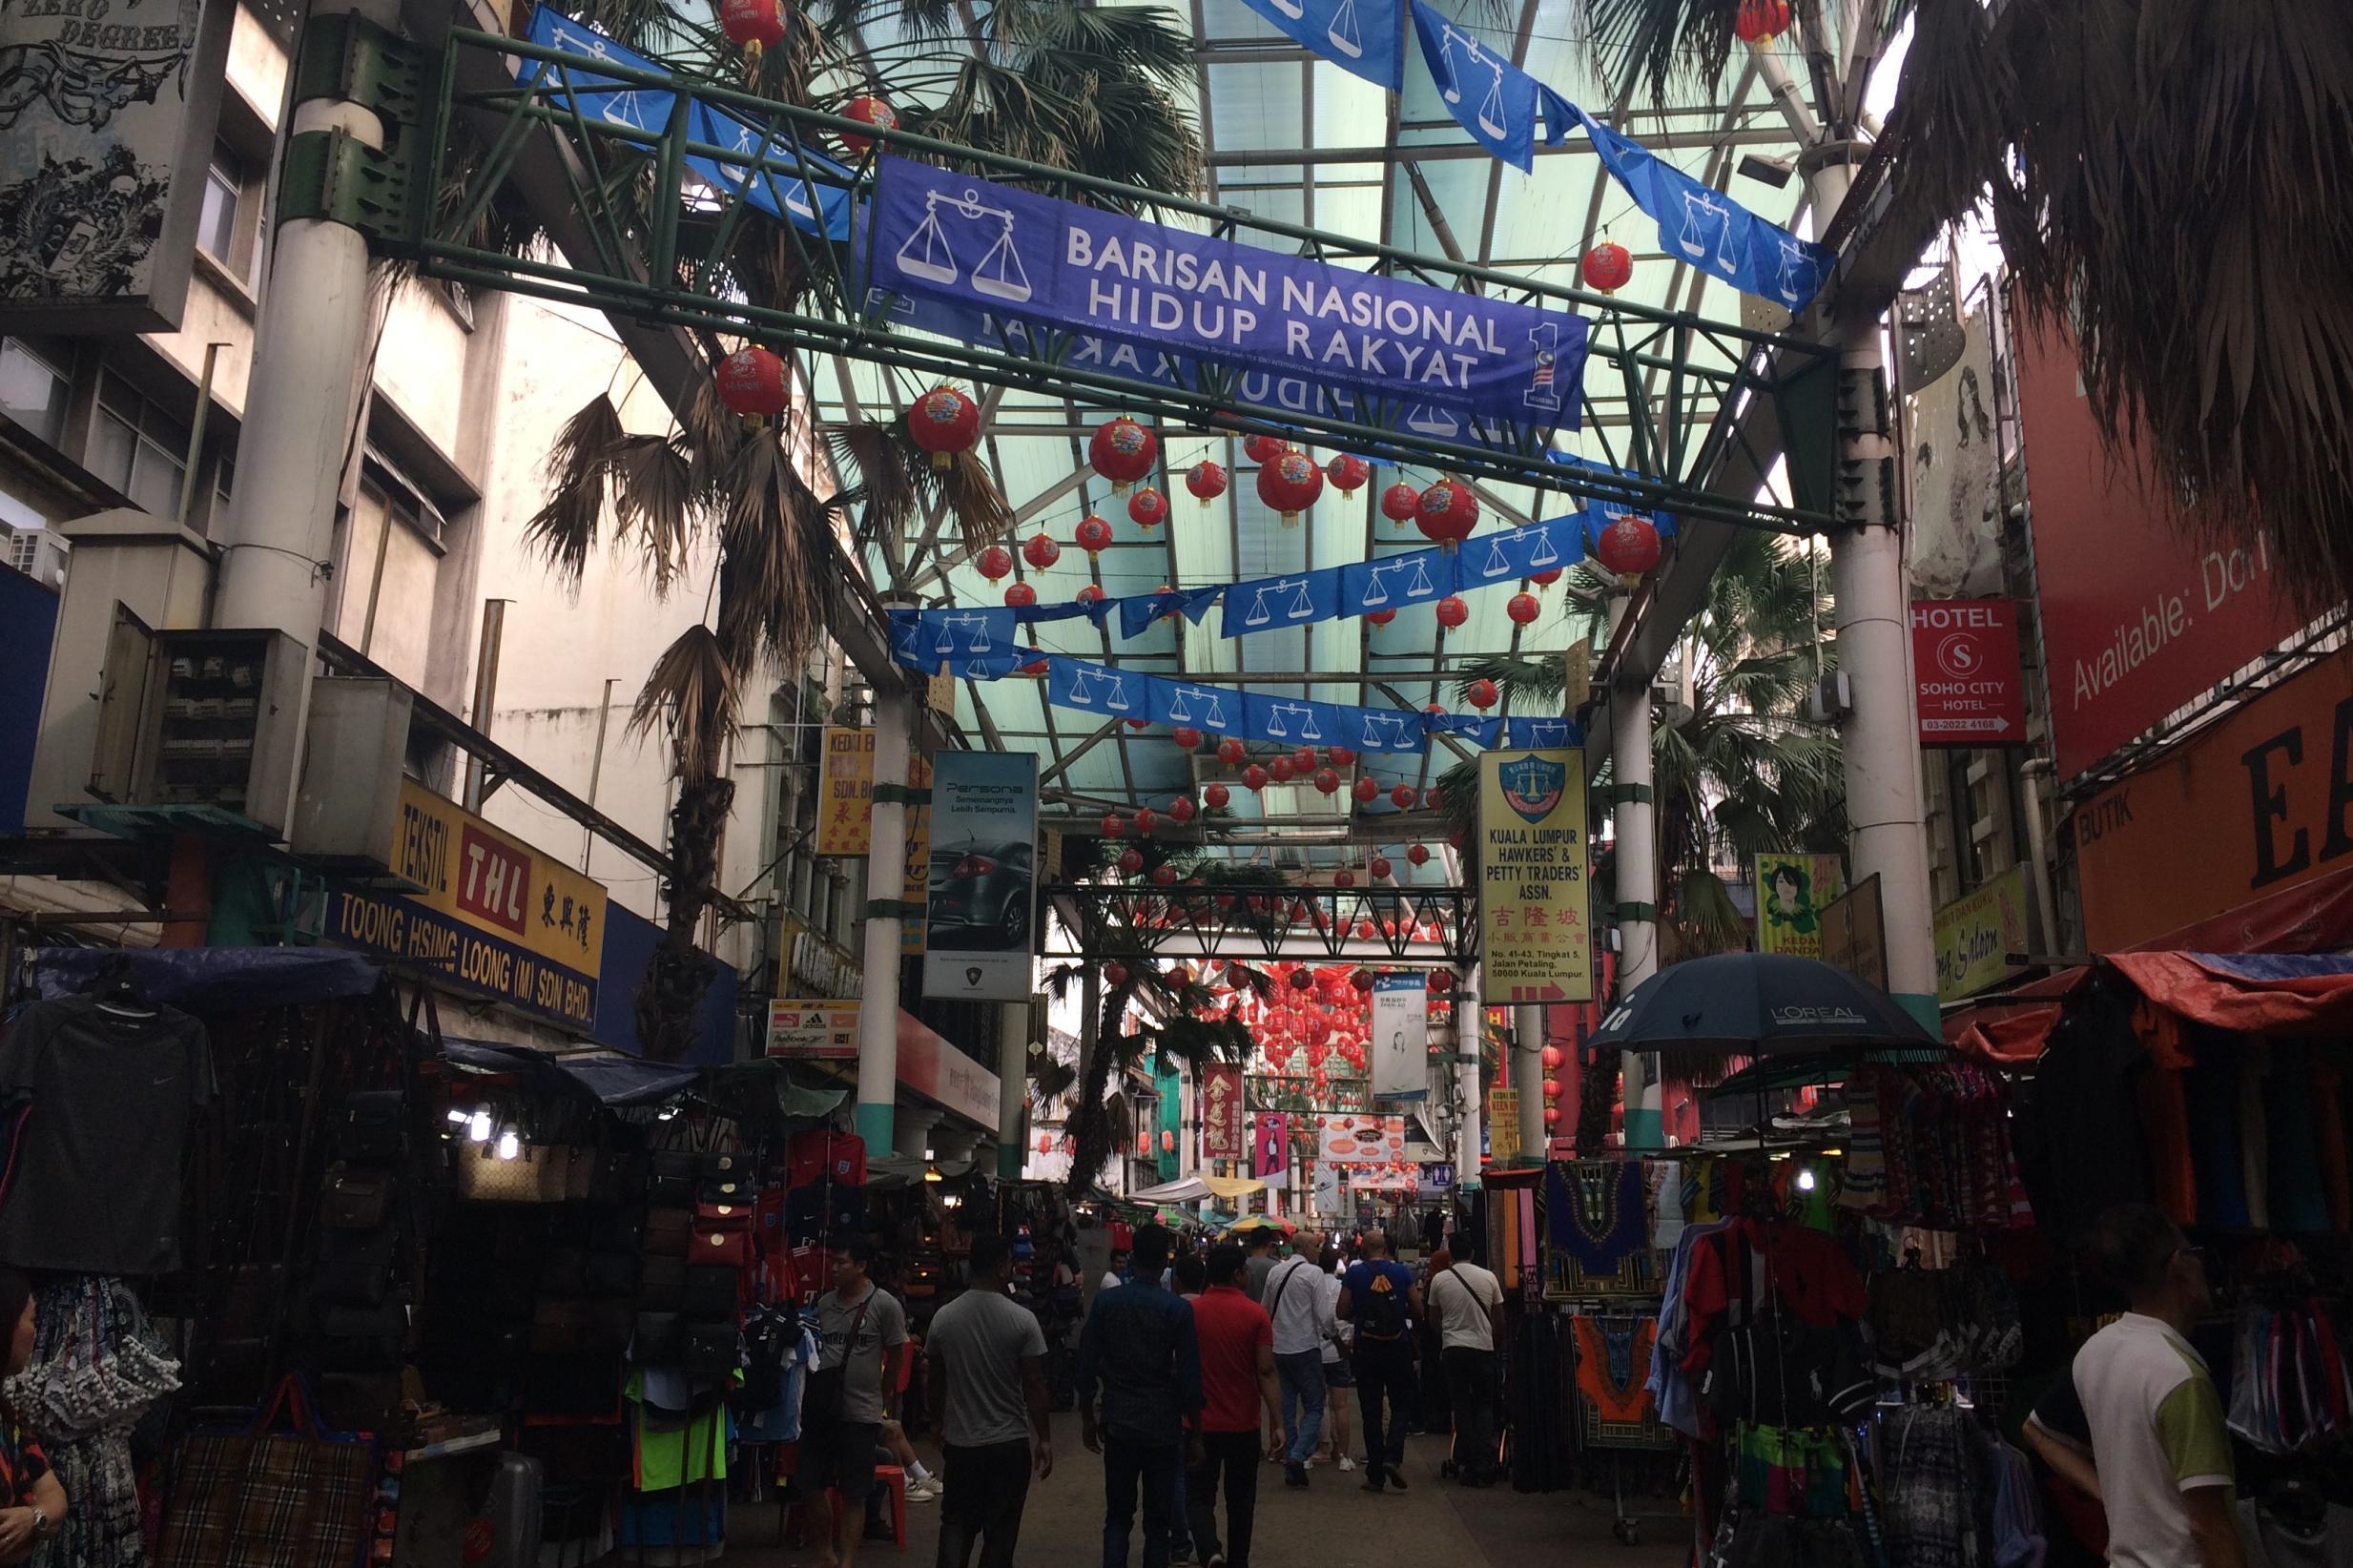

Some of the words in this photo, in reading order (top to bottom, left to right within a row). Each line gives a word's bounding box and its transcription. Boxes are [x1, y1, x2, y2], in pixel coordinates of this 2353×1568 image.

[21, 0, 110, 20] ZERO
[57, 18, 179, 51] DEGREE
[1066, 226, 1267, 306] BARISAN
[1282, 276, 1507, 356] NASIONAL
[1088, 279, 1257, 344] HIDUP
[1287, 320, 1478, 389] RAKYAT
[1910, 608, 2003, 629] HOTEL
[2074, 587, 2193, 711] Available:
[1920, 682, 1966, 695] SOHO
[1970, 682, 2004, 694] CITY
[1943, 700, 1986, 711] HOTEL
[1927, 720, 1968, 730] 03-2022
[1971, 719, 1995, 729] 4168
[946, 782, 1023, 794] Persona
[2078, 788, 2134, 847] BUTIK
[1489, 829, 1527, 844] KUALA
[1533, 828, 1578, 844] LUMPUR
[400, 803, 449, 894] TEKSTIL
[1498, 845, 1558, 863] HAWKERS'
[1561, 848, 1570, 862] &
[1486, 865, 1521, 881] PETTY
[1526, 863, 1582, 881] TRADERS'
[465, 842, 521, 921] THL
[1518, 884, 1553, 900] ASSN.
[1490, 905, 1581, 927] 吉隆坡
[1783, 937, 1821, 945] KEDAI
[341, 893, 404, 954] TOONG
[408, 916, 458, 971] HSING
[460, 937, 510, 993] LOONG
[513, 956, 535, 1002] (M)
[537, 967, 564, 1011] SDN
[1491, 950, 1506, 959] No.
[1537, 950, 1570, 959] Tingkat
[1492, 959, 1517, 968] Jalan
[1492, 969, 1518, 978] 50000
[1520, 969, 1547, 978] Kuala
[1548, 969, 1585, 979] Lumpur.
